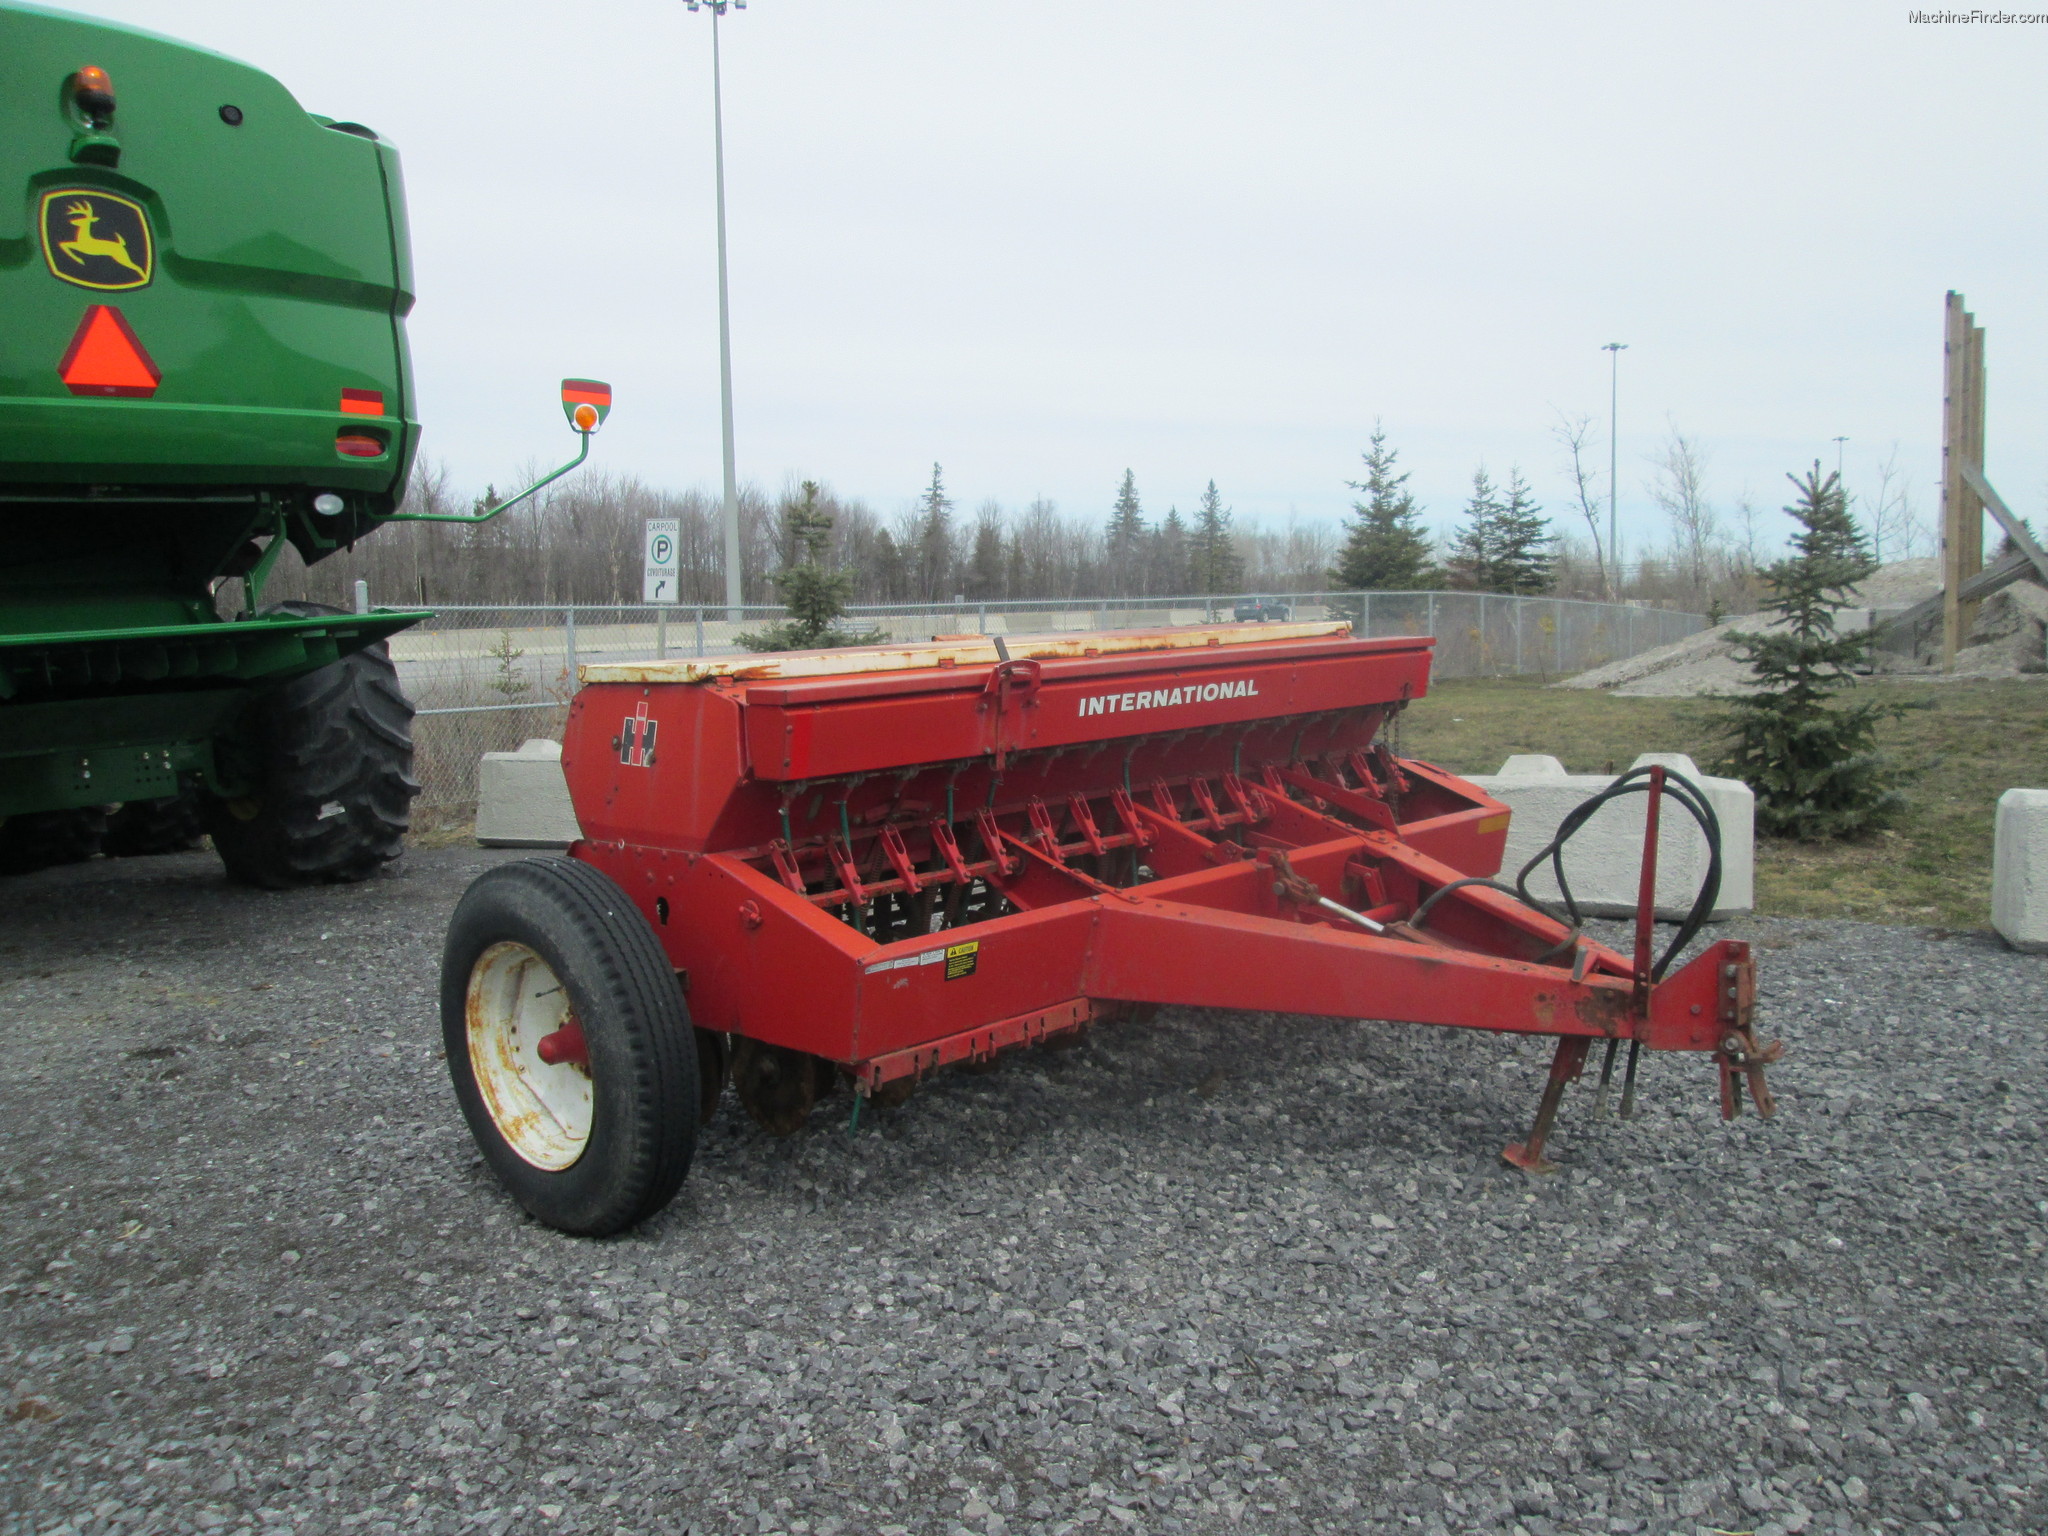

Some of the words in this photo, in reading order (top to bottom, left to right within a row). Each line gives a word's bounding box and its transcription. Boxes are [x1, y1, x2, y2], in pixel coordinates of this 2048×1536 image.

[648, 522, 677, 531] CARPOOL
[657, 540, 668, 558] P
[1078, 679, 1259, 717] INTERNATIONAL
